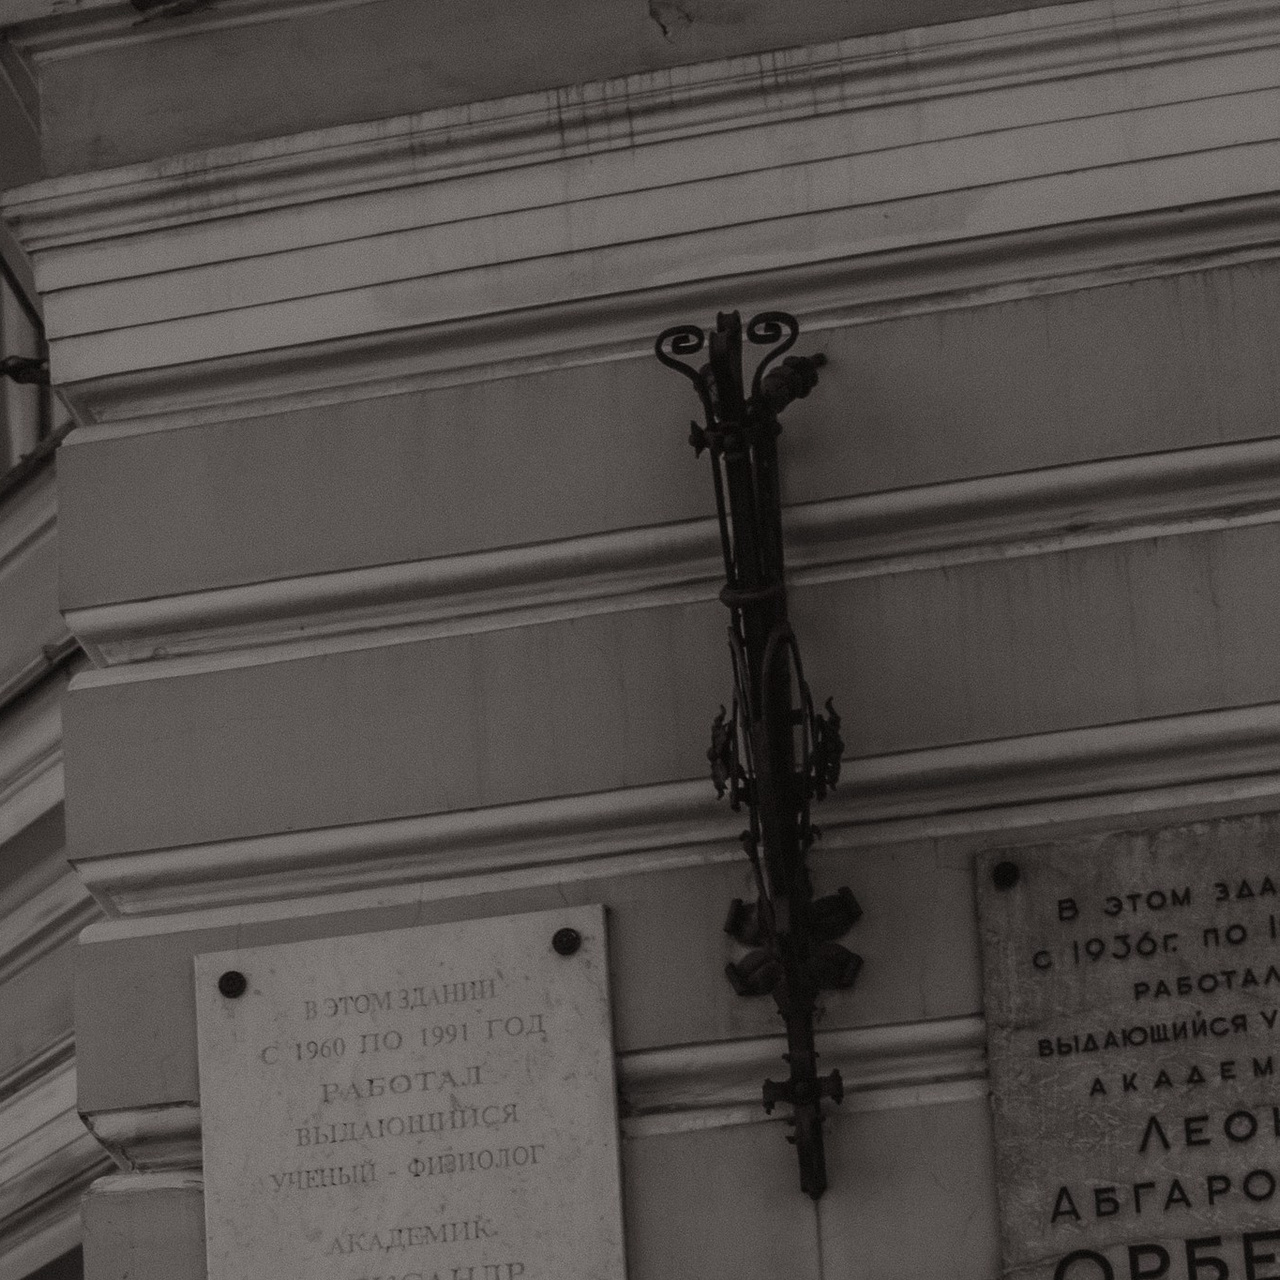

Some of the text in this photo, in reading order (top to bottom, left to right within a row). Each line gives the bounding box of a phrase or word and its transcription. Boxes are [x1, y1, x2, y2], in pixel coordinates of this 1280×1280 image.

[1057, 897, 1079, 922] В
[1103, 887, 1192, 917] ЭТОМ
[303, 979, 498, 1020] В ЭТОМ ЗДАНИИ
[1133, 965, 1280, 1001] РАБОТАЛ
[260, 1014, 547, 1066] С 1960 ПО 1991 ГОД
[1037, 1010, 1248, 1058] ВЫДАЮЩИЙСЯ
[320, 1065, 483, 1103] РАБОТАЛ
[295, 1102, 520, 1147] ВЫДАЮЩИЙСЯ
[268, 1158, 378, 1195] УЧЕНЫЙ
[407, 1143, 546, 1179] ФИЗИОЛОГ
[1051, 1169, 1276, 1224] АБГАРО
[325, 1217, 496, 1257] АКАДЕМИК
